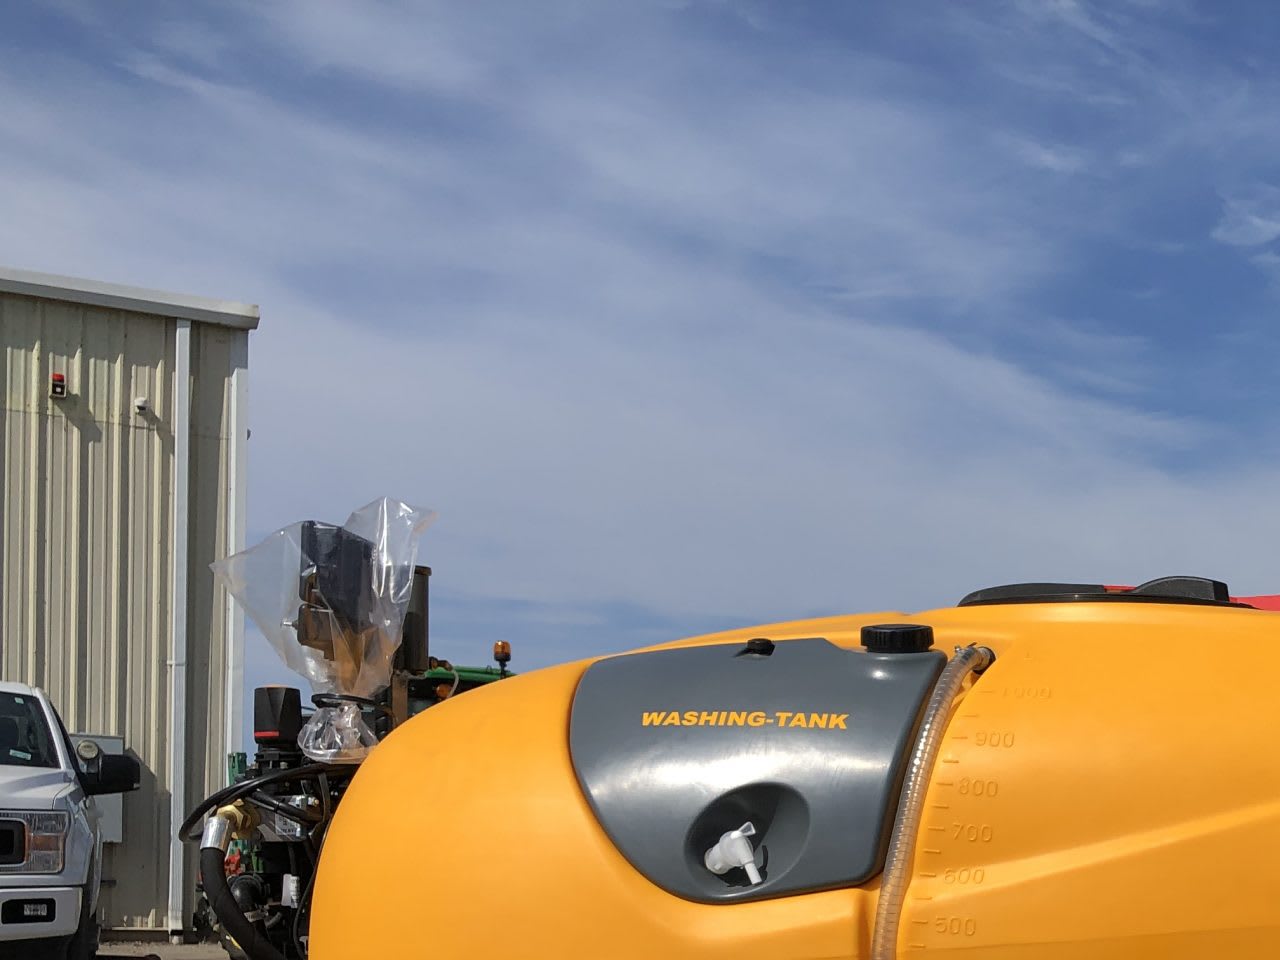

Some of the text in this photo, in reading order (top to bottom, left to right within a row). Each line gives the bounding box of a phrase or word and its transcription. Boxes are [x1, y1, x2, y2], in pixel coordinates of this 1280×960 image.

[641, 711, 849, 730] WASHING-TANK
[975, 732, 1016, 748] 900
[951, 823, 993, 843] 700
[943, 867, 985, 884] 600
[935, 915, 977, 936] 500
